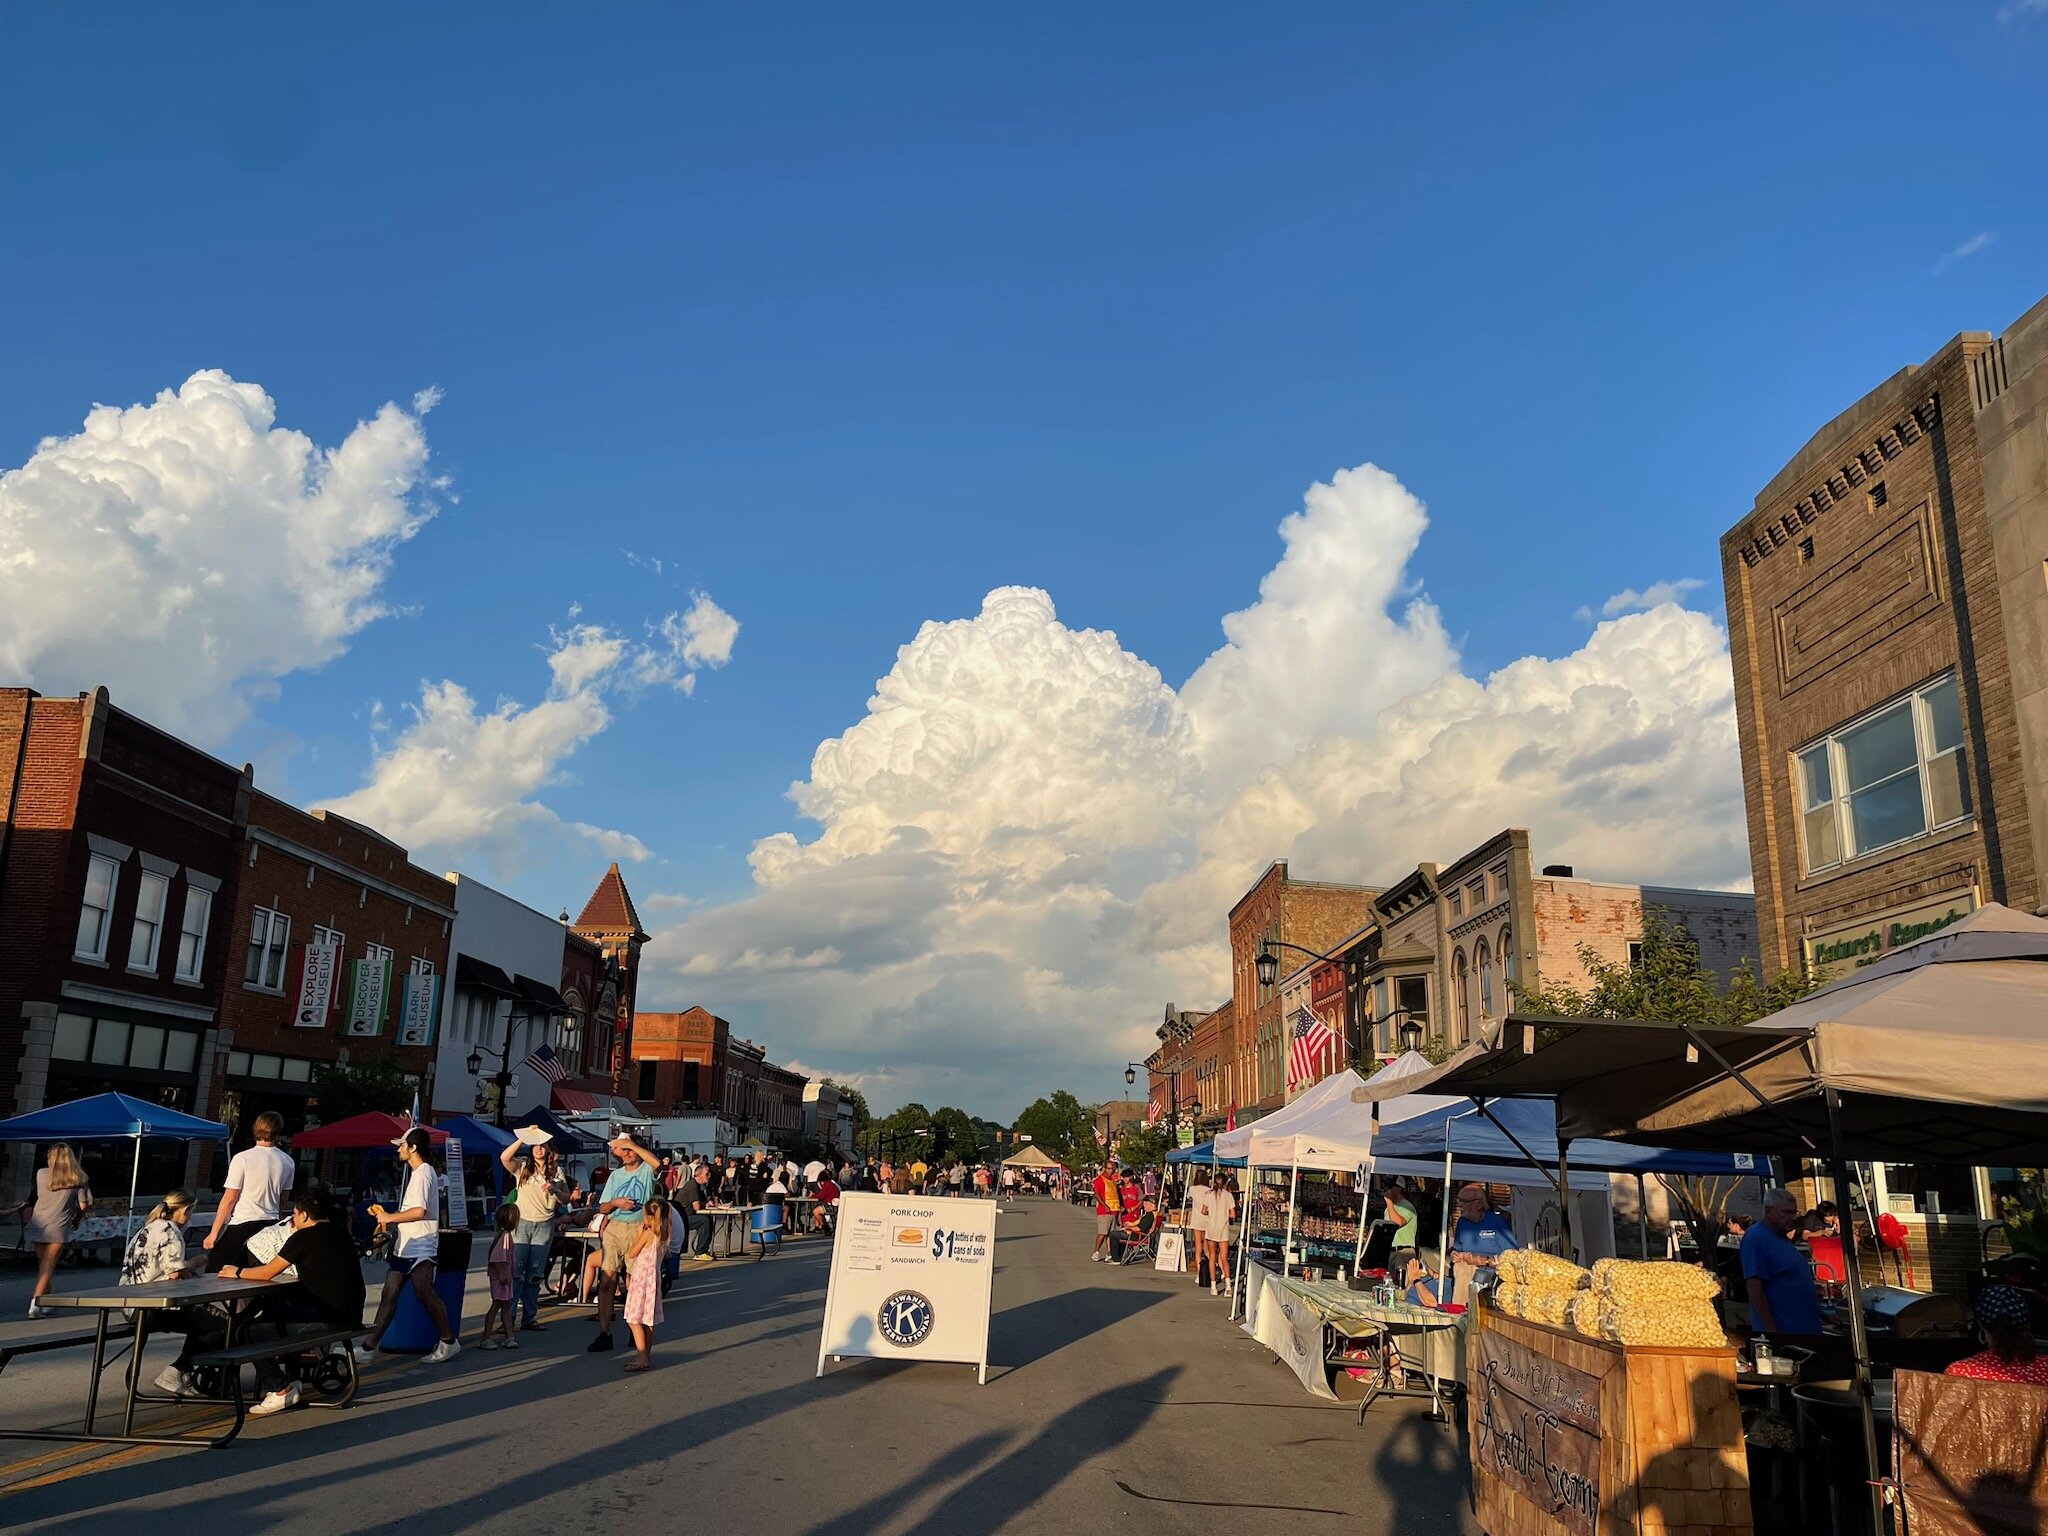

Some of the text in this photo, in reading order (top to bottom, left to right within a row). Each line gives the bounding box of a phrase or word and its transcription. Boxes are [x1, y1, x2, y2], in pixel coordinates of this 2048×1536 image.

[303, 948, 320, 1006] EXPLORE
[315, 951, 332, 1007] MUSEUM
[355, 962, 371, 1018] DISCOVER
[367, 966, 382, 1018] MUSEUM
[408, 990, 420, 1027] LEARN
[419, 978, 432, 1028] MUSEUM
[890, 1208, 934, 1218] PORK CHOP
[932, 1228, 955, 1261] $1
[954, 1245, 985, 1256] cans of soda
[889, 1295, 926, 1309] KIWANIS
[895, 1302, 919, 1336] K
[882, 1312, 930, 1343] INTERNATIONAL
[1502, 1350, 1529, 1386] Sweet
[1480, 1360, 1597, 1520] Kettle Corn
